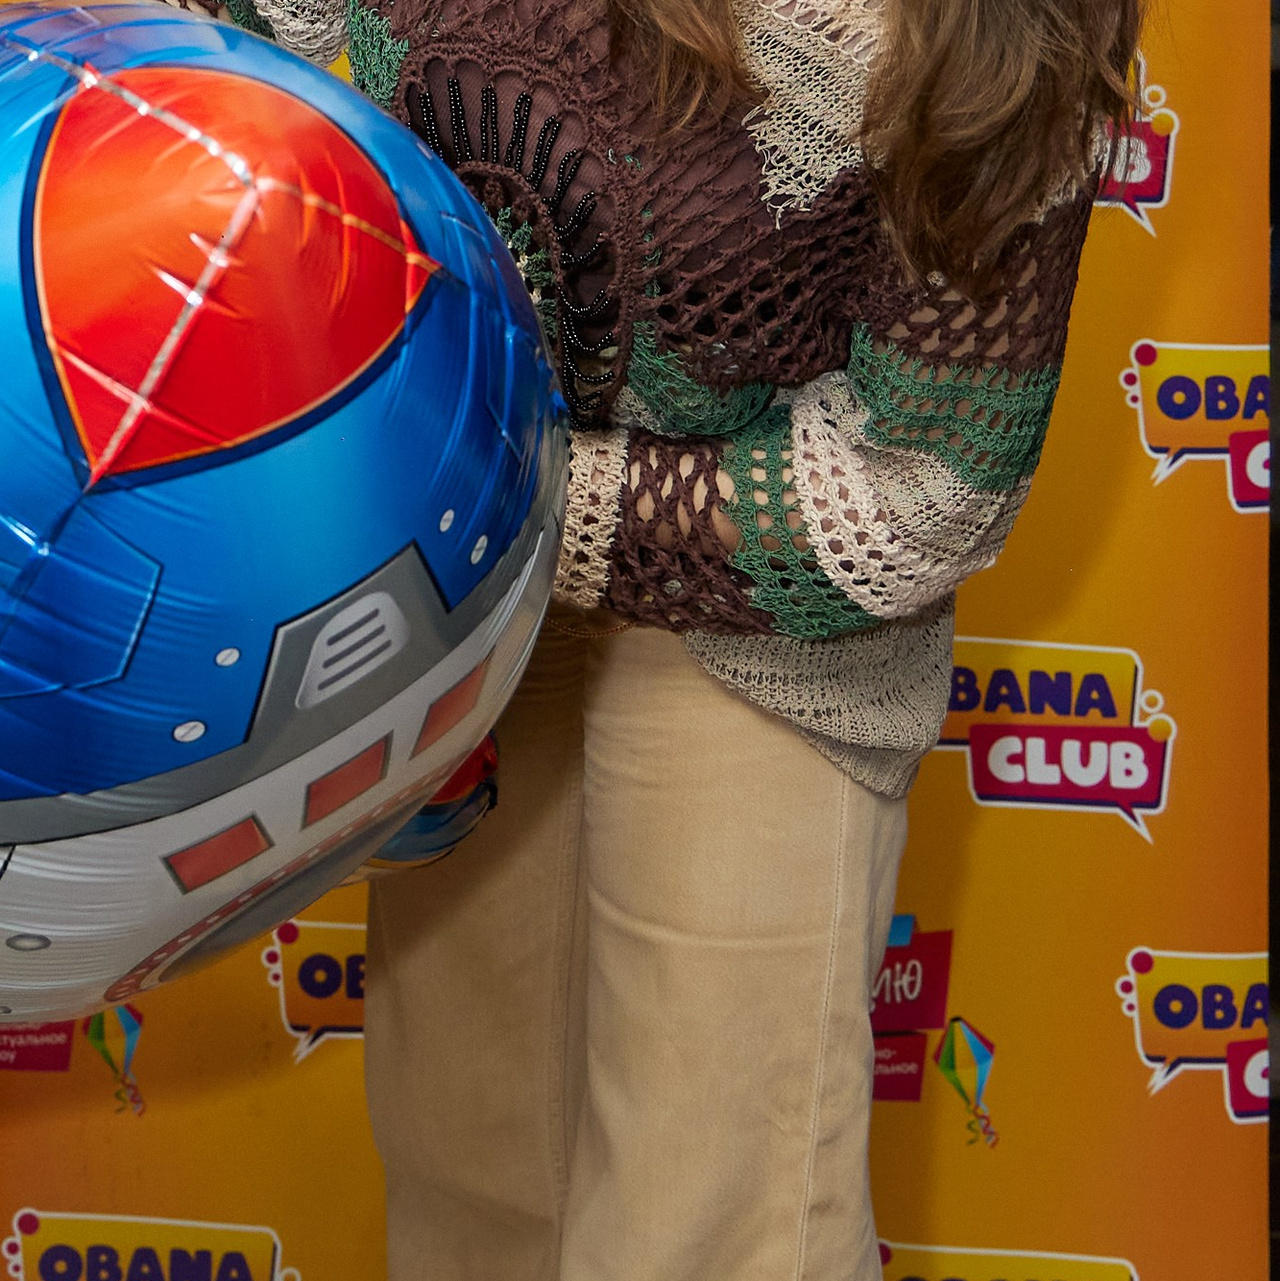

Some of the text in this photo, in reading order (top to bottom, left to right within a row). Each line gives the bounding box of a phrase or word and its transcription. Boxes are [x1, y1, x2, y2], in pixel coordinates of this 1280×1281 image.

[1157, 375, 1270, 420] OBA
[948, 667, 1117, 718] BANA
[988, 736, 1149, 790] CLUB
[1153, 983, 1269, 1029] OBA
